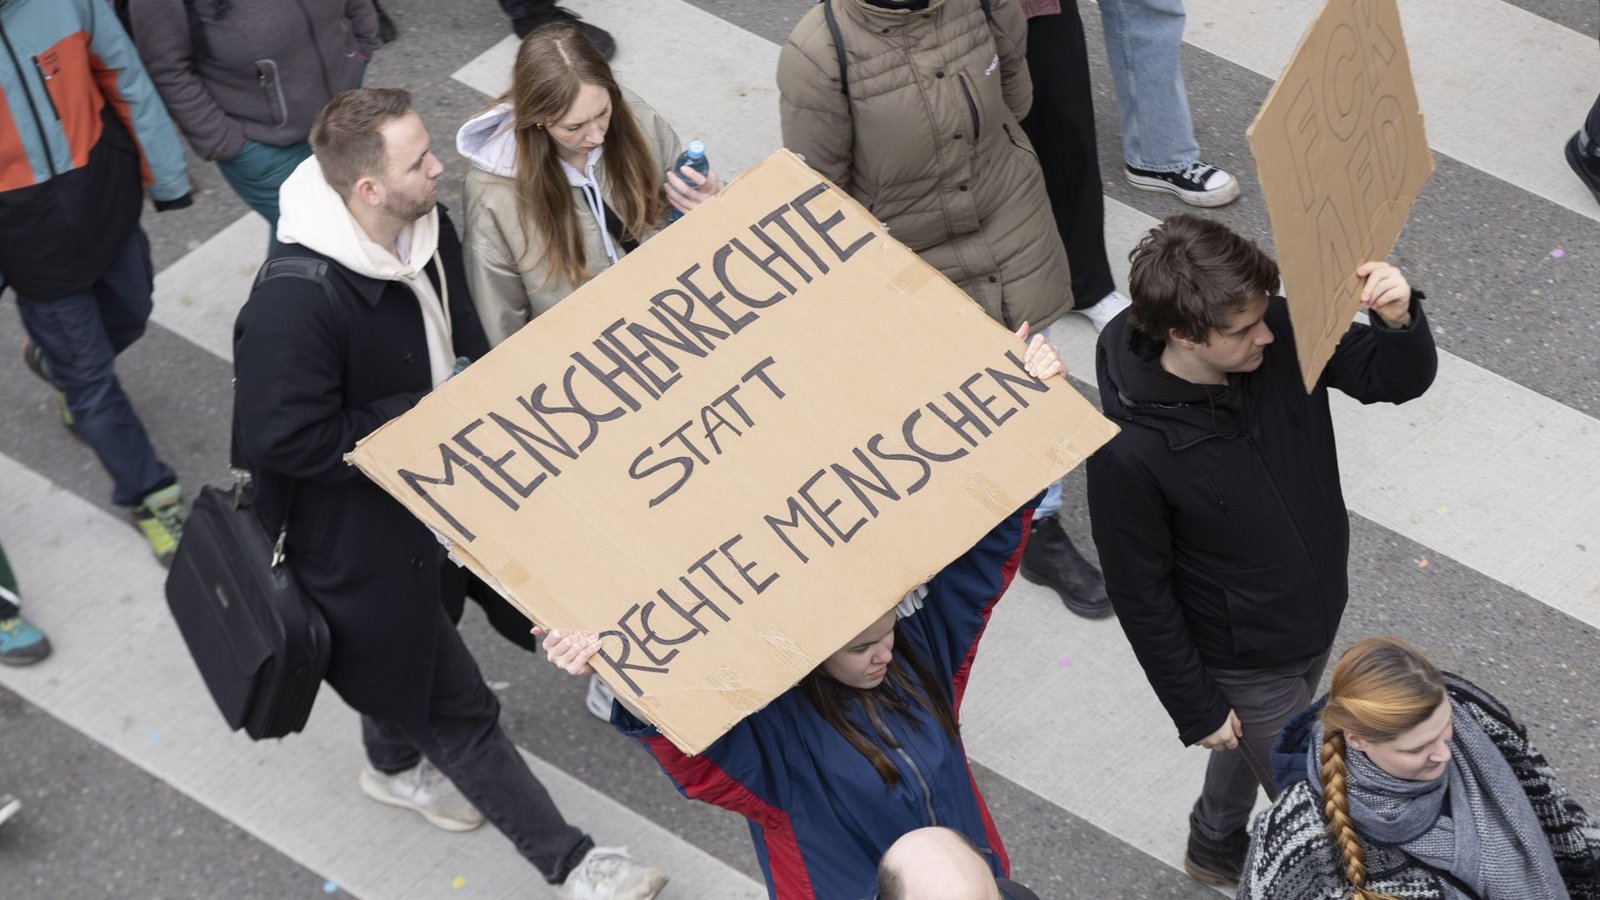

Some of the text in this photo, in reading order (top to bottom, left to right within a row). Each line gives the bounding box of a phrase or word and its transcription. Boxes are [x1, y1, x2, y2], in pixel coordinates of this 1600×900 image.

[1283, 0, 1397, 213] FCK
[397, 182, 876, 542] MENSCHENRECHTE
[628, 356, 786, 508] STATT
[597, 349, 1050, 698] RECHTE MENSCHEN
